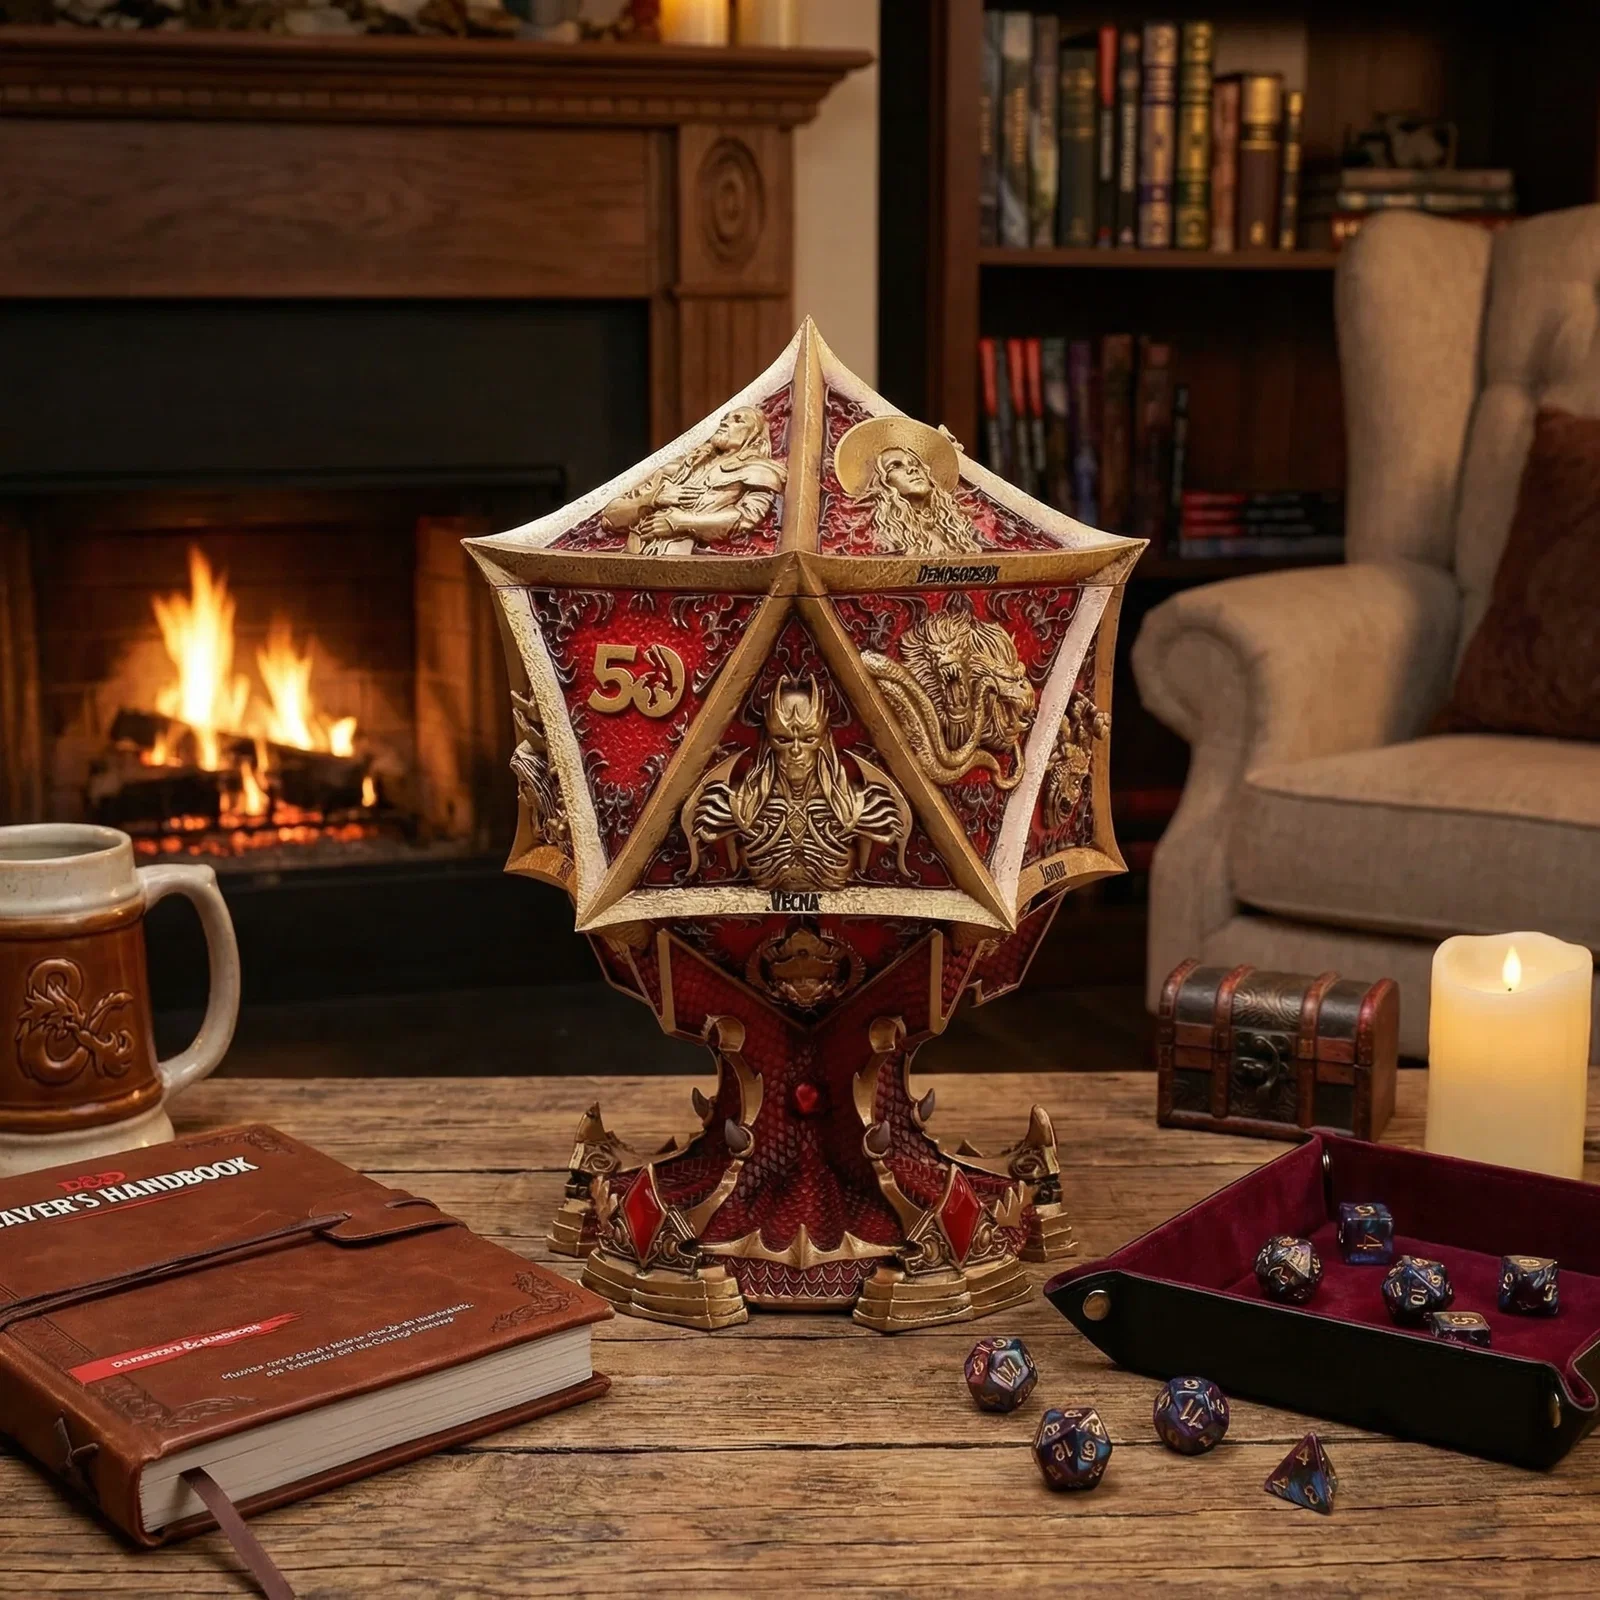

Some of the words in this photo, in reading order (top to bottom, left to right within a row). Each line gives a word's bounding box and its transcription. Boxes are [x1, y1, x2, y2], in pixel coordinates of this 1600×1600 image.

[587, 643, 685, 718] 50
[770, 890, 822, 912] VECNA
[0, 1192, 101, 1230] AYER'S
[97, 1155, 260, 1204] HANDBOOK
